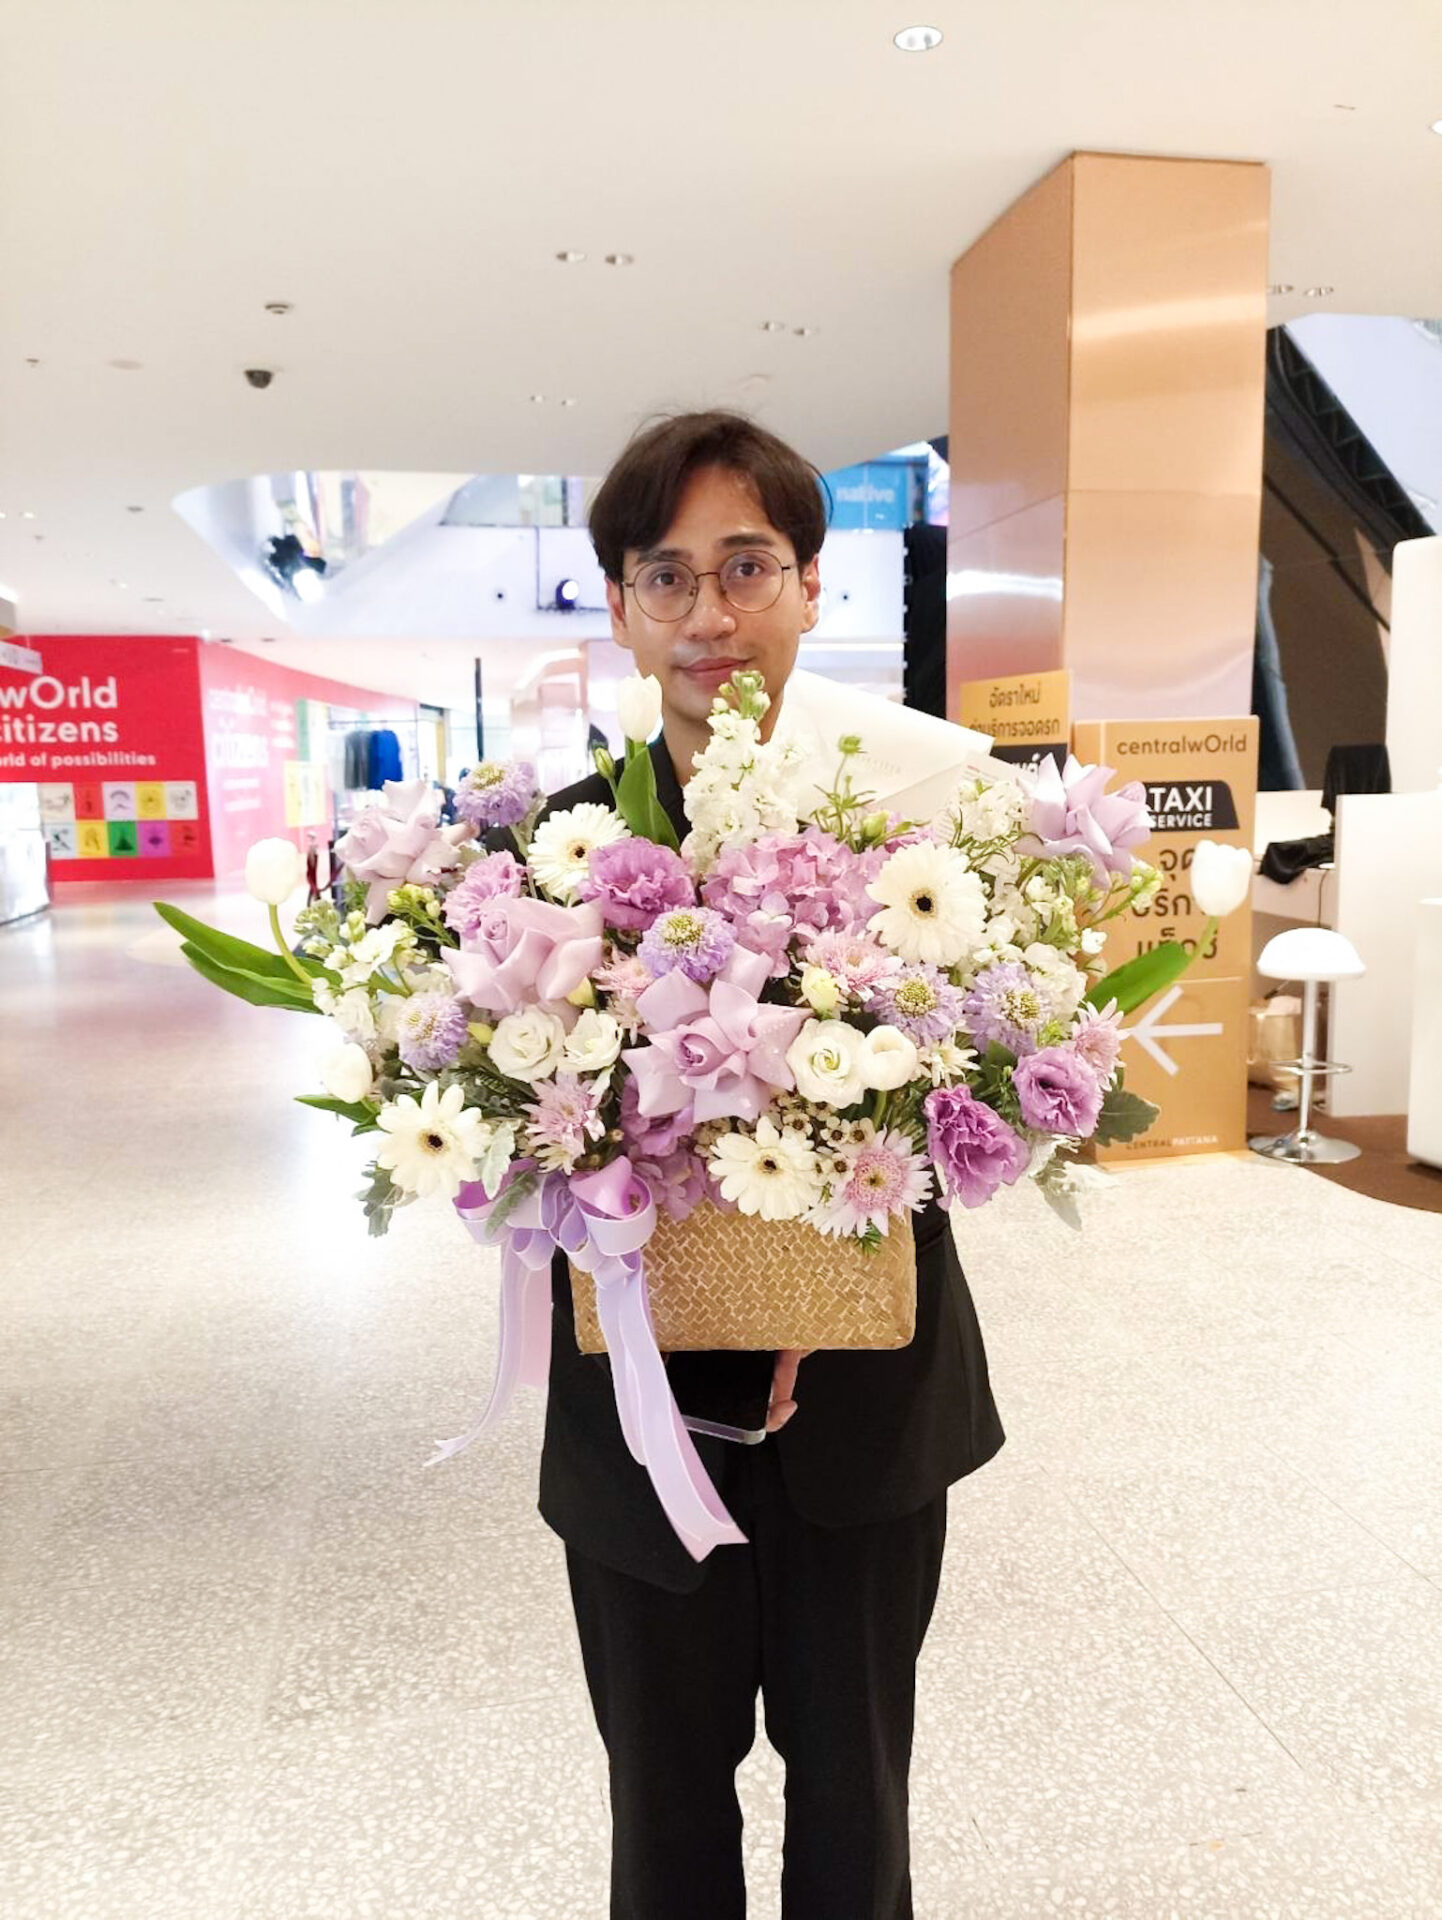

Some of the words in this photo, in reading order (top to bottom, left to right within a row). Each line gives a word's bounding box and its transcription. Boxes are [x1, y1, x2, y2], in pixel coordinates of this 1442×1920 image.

[0, 714, 119, 743] itizens
[1116, 734, 1247, 755] centralwOrld
[0, 753, 26, 767] rld
[30, 753, 47, 767] of
[51, 752, 156, 769] possibilities
[1149, 786, 1213, 813] TAXI
